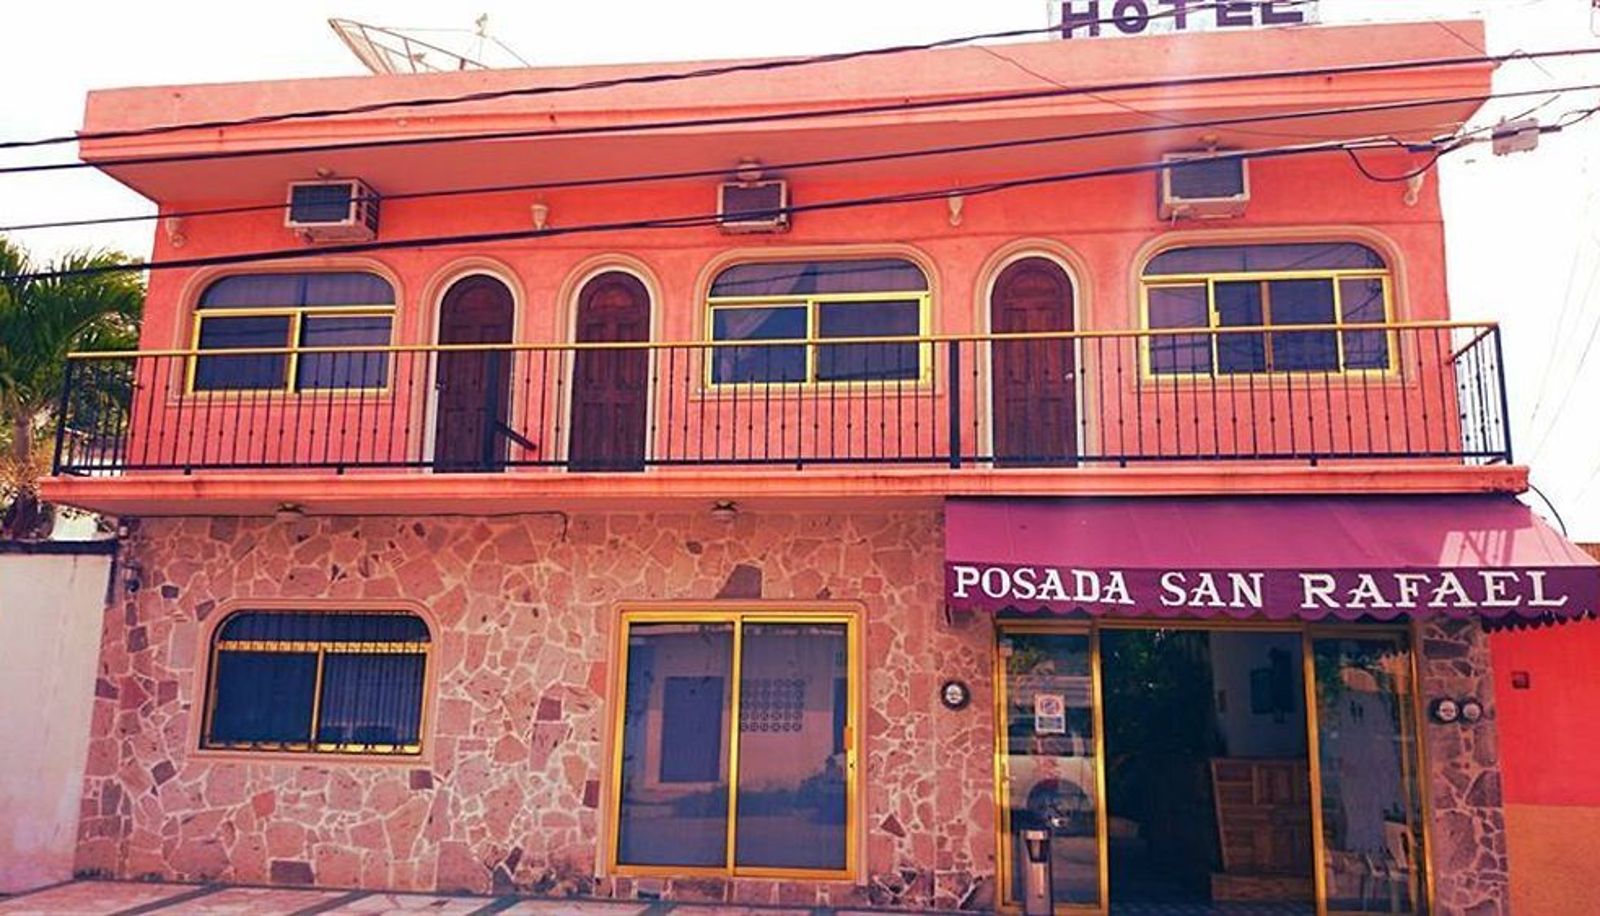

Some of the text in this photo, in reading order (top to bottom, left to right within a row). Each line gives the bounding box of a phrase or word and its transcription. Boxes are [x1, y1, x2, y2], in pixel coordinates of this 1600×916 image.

[1061, 0, 1304, 40] HOTEL
[952, 565, 1569, 609] POSADA SAN RAFAEL
